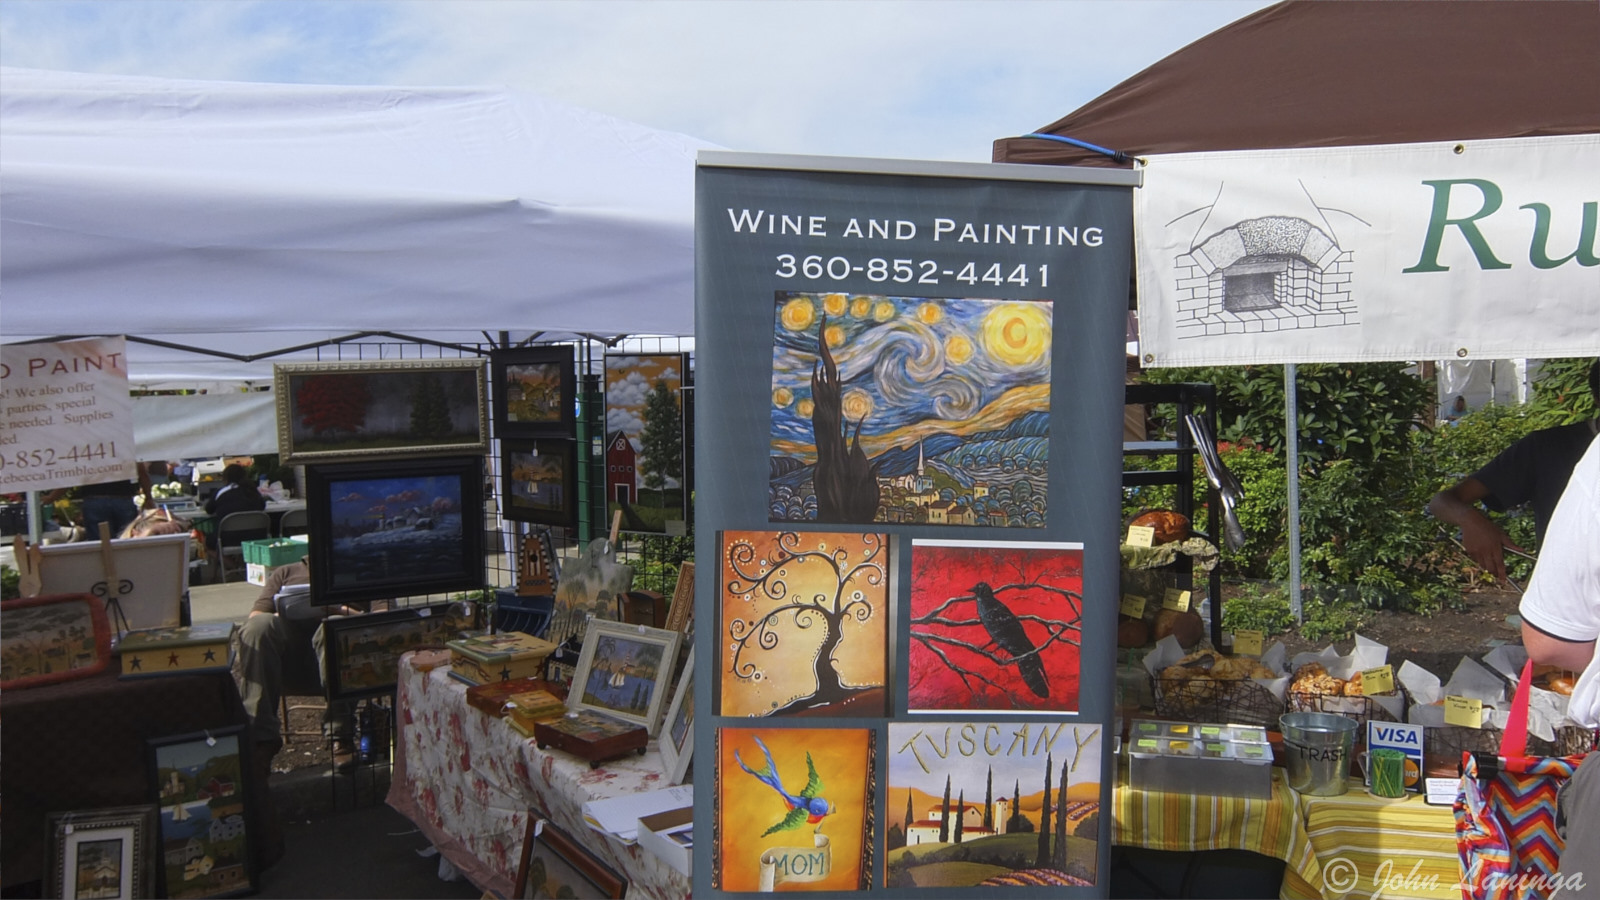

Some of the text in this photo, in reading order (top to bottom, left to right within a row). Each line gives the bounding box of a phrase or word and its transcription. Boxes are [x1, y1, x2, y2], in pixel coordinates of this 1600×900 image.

[775, 254, 1050, 288] 360-852-4441
[15, 387, 36, 398] We
[39, 384, 64, 396] also
[67, 381, 96, 394] offer
[55, 396, 97, 412] special
[9, 416, 56, 430] needed.
[64, 410, 115, 425] Supplies
[1374, 727, 1418, 744] VISA
[898, 722, 1100, 774] TUSCANY
[1297, 745, 1347, 762] TRASH
[774, 852, 825, 875] MOM
